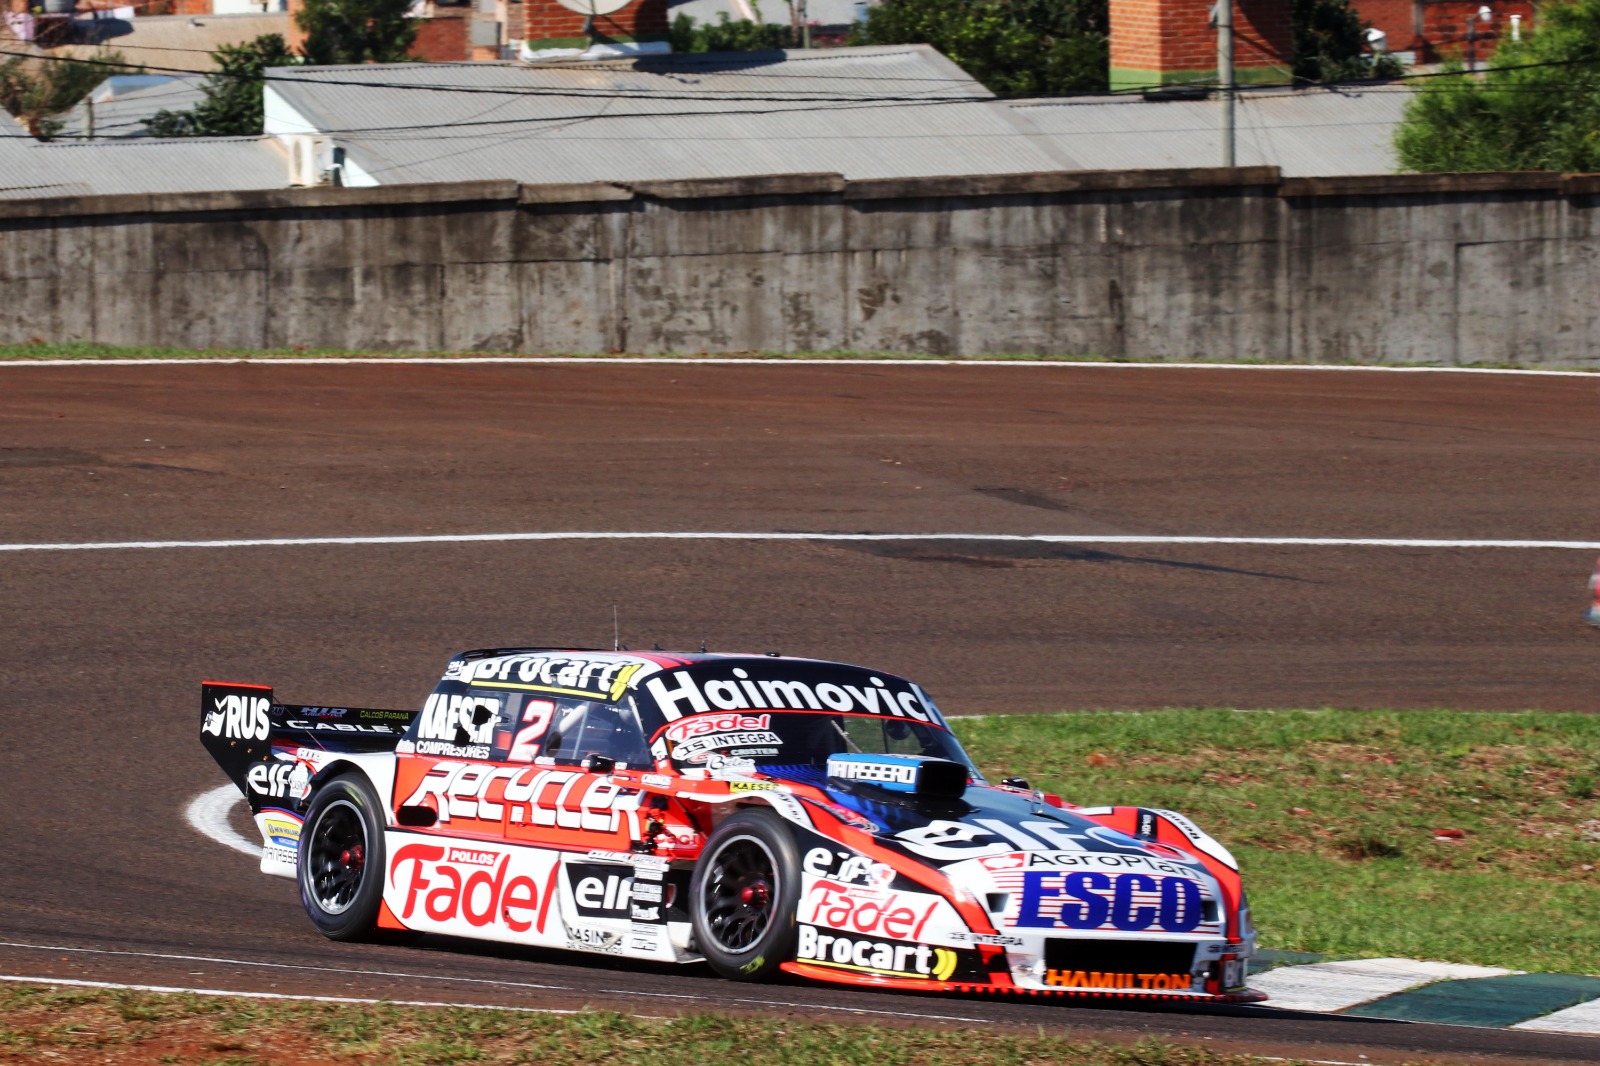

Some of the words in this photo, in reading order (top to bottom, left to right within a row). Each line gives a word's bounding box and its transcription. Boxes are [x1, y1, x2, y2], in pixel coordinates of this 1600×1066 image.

[474, 655, 621, 691] Brocart
[646, 668, 942, 725] Haimovich
[226, 695, 270, 740] RUS
[286, 720, 393, 733] CABLE
[360, 710, 383, 719] CALCOS
[508, 700, 555, 761] 2
[669, 715, 769, 741] Fadel
[416, 740, 490, 759] COMPRESORES
[712, 732, 777, 747] INTEGRA
[247, 764, 293, 797] elf
[450, 850, 495, 865] POLLOS
[390, 843, 562, 934] Fadel
[575, 875, 635, 910] elf
[1016, 871, 1202, 933] ESCO
[808, 880, 939, 941] Fadel
[797, 924, 932, 975] Brocart
[1046, 969, 1191, 990] HAMILTON
